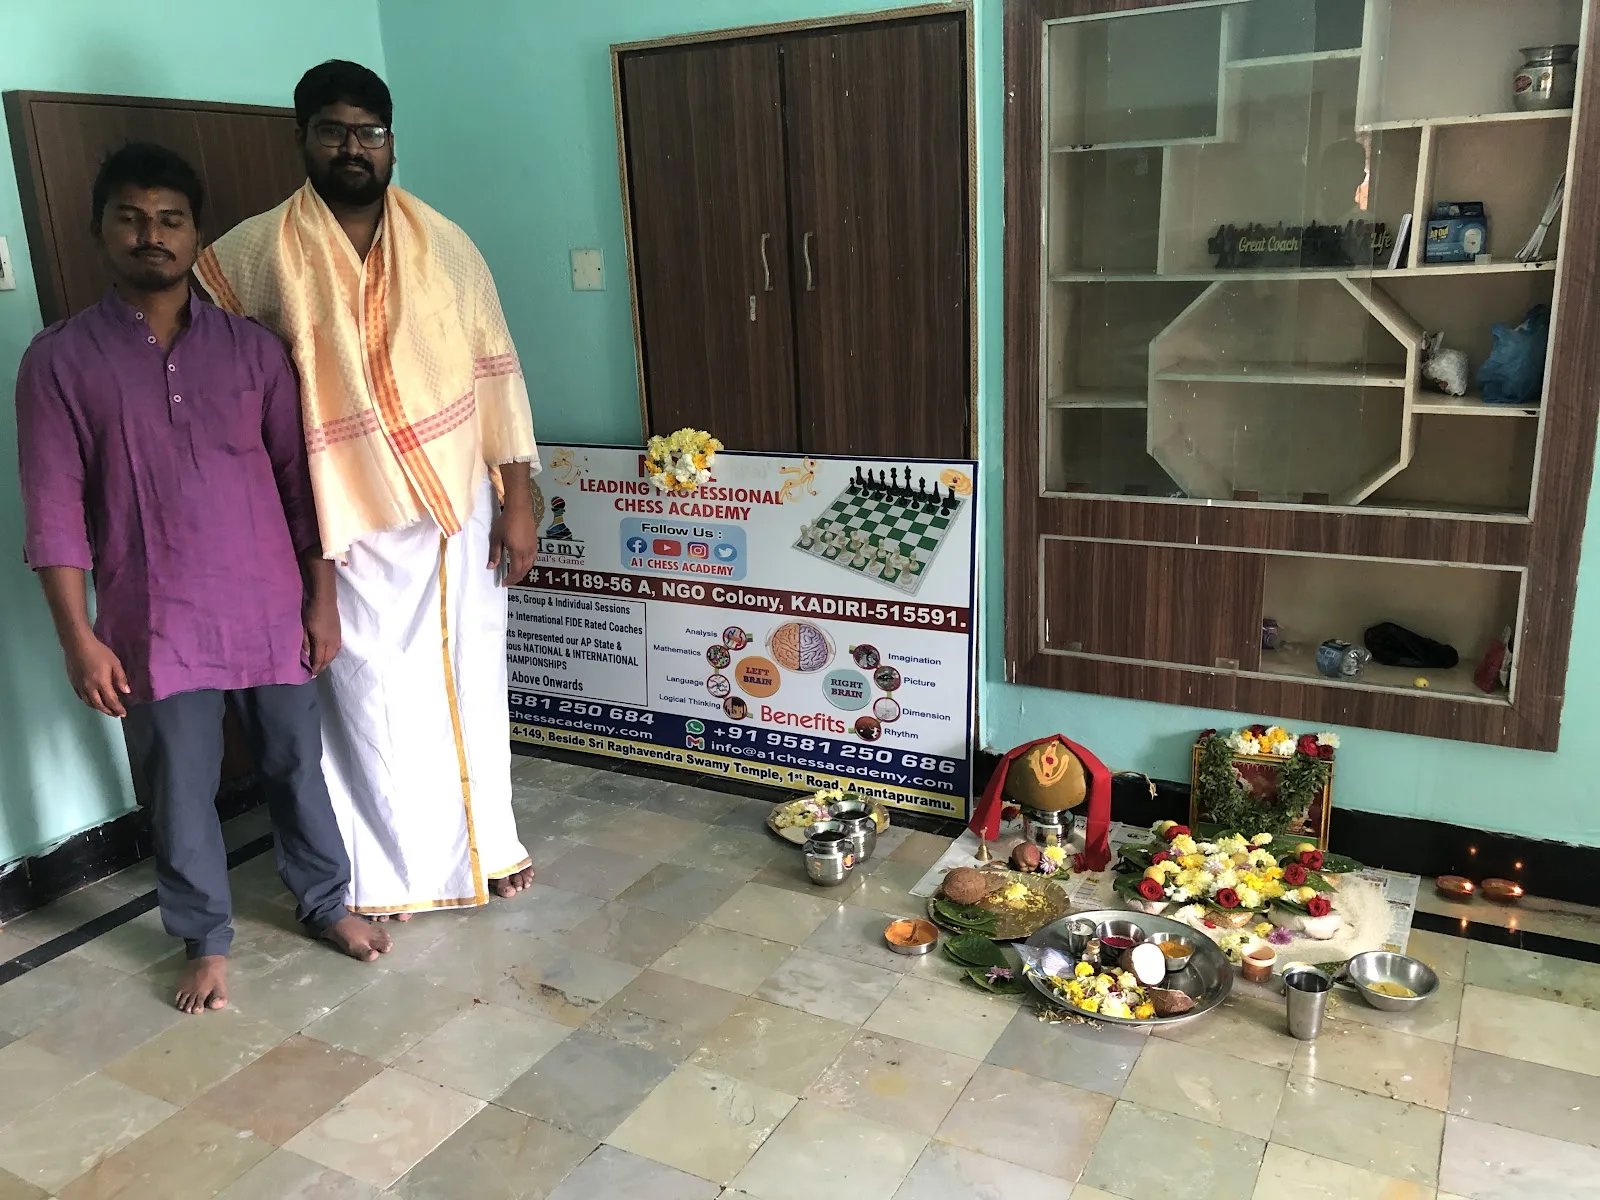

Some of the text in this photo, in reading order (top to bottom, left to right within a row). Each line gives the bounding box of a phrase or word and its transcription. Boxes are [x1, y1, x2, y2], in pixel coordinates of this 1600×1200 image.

[1238, 236, 1266, 252] Great
[1268, 235, 1299, 252] Coach
[580, 478, 650, 495] LEADING
[614, 498, 752, 521] CHESS ACADEMY
[641, 523, 688, 537] Follow
[693, 527, 714, 539] Us
[537, 538, 585, 558] demy
[558, 555, 585, 566] Game
[631, 558, 733, 576] A1 CHESS ACADEMY
[508, 594, 630, 615] ses, Group & Individual Sessions
[528, 570, 967, 628] # 1-1189-56 A, NGO Colony, KADIRI-515591.
[516, 611, 564, 626] International
[565, 616, 582, 628] FIDE
[584, 618, 607, 631] Rated
[609, 622, 643, 636] Coaches
[518, 629, 564, 644] Represented
[566, 637, 579, 646] our
[580, 637, 592, 647] AP
[594, 638, 614, 650] State
[616, 640, 622, 651] &
[685, 628, 718, 638] Analysis
[523, 643, 563, 657] NATIONAL
[565, 648, 571, 658] &
[572, 649, 639, 667] INTERNATIONAL
[653, 644, 701, 657] Mathematics
[507, 653, 567, 670] HAMPIONSHIPS
[888, 653, 942, 666] Imagination
[745, 667, 770, 676] LEFT
[512, 670, 584, 692] Above Onwards
[666, 675, 704, 687] Language
[743, 675, 772, 686] BRAIN
[831, 678, 863, 689] RIGHT
[903, 677, 936, 688] Picture
[659, 693, 721, 710] Logical Thinking
[831, 688, 863, 699] BRAIN
[510, 693, 655, 725] 581 250 684
[902, 708, 951, 721] Dimension
[508, 710, 653, 740] chessacademy.com
[760, 705, 846, 734] Benefits
[884, 728, 919, 740] Rhythm
[713, 726, 956, 774] +91 9581 250 686
[548, 731, 586, 748] Beside
[588, 737, 604, 750] Sri
[607, 742, 683, 763] Raghavendra
[686, 753, 730, 773] Swamy
[733, 762, 783, 783] Temple,
[806, 774, 844, 791] Road,
[847, 782, 955, 811] Anantapuramu.
[711, 741, 953, 791] info@a1chessacademy.com
